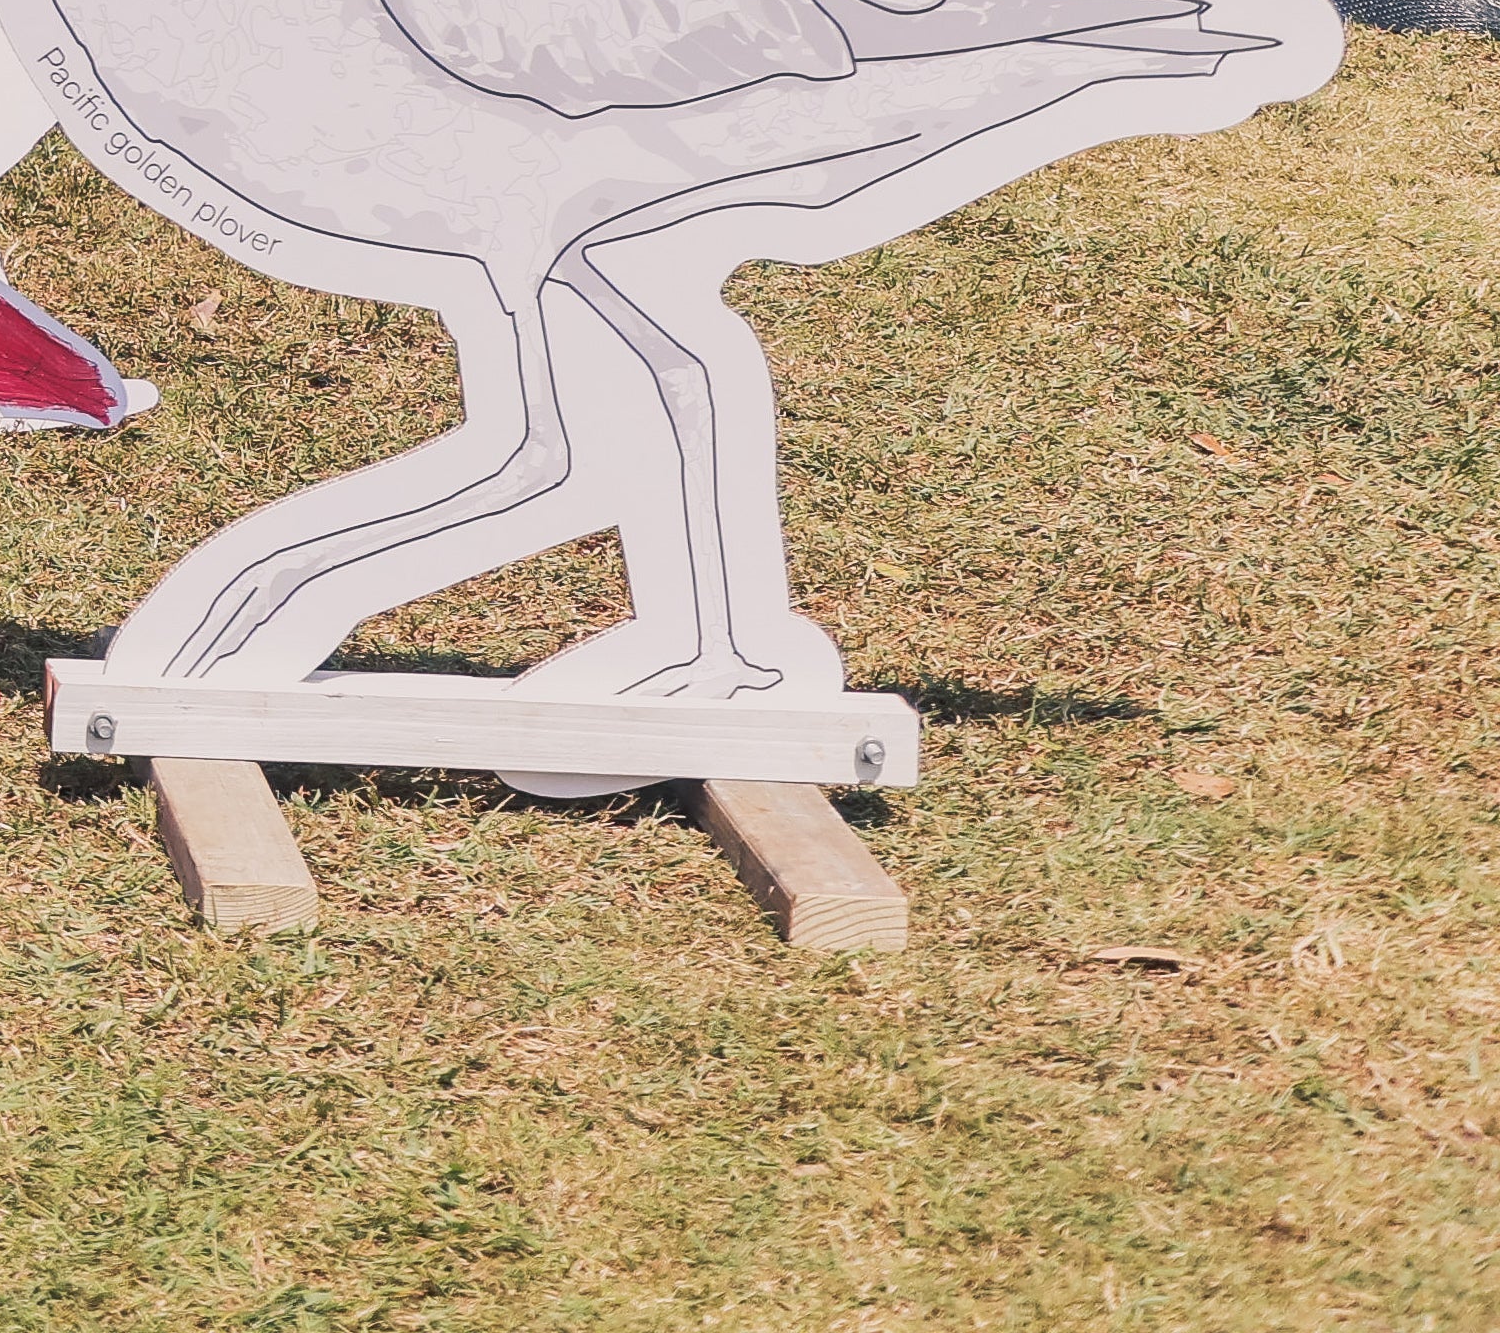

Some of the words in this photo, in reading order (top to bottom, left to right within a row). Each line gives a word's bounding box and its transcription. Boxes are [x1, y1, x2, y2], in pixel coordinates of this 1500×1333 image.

[37, 46, 110, 131] Pacific
[104, 131, 193, 207] golden
[191, 201, 283, 256] plover
